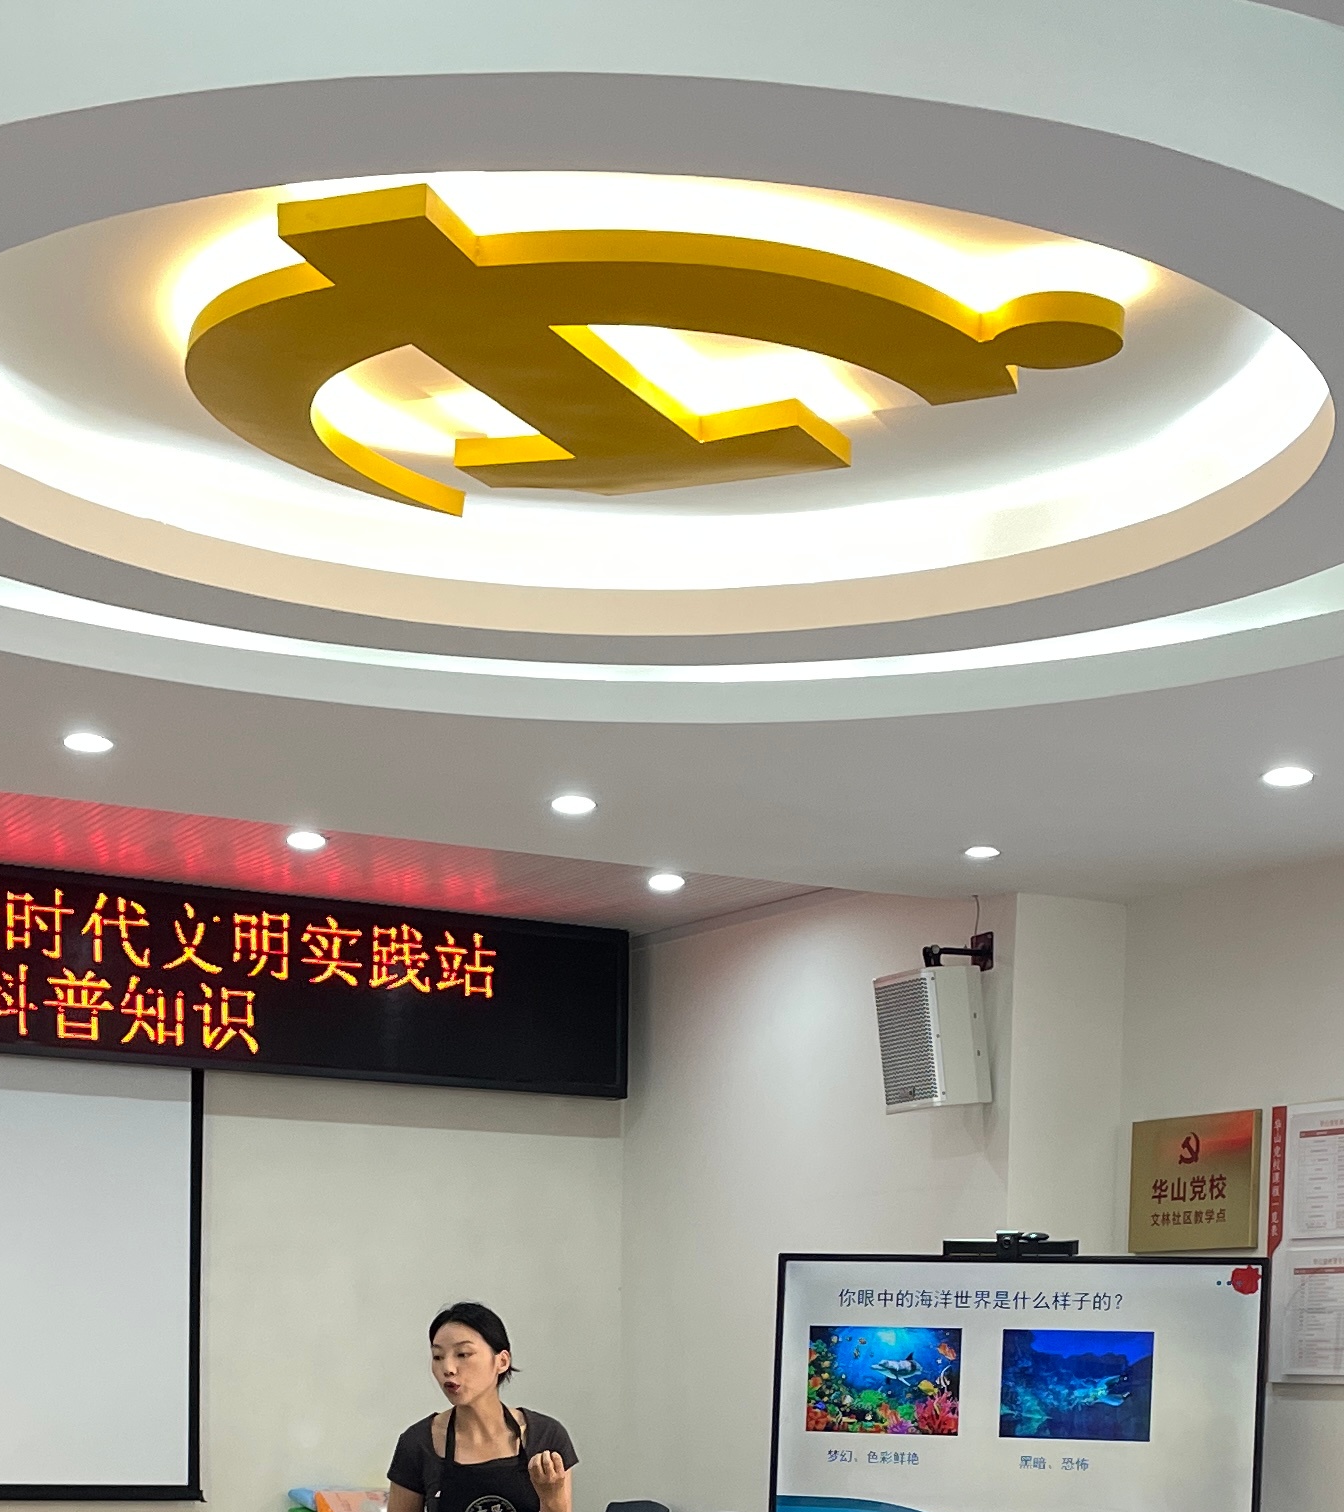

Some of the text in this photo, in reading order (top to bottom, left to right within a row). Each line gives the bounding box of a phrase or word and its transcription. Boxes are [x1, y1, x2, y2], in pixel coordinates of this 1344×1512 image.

[1151, 1173, 1227, 1204] 华山党校
[1150, 1208, 1226, 1227] 文林社区教学点
[838, 1288, 1124, 1312] 你眼中的海洋世界是什么样子的?
[826, 1448, 920, 1466] 梦幻、色彩鲜艳
[1018, 1454, 1090, 1472] 黑暗、恐怖
